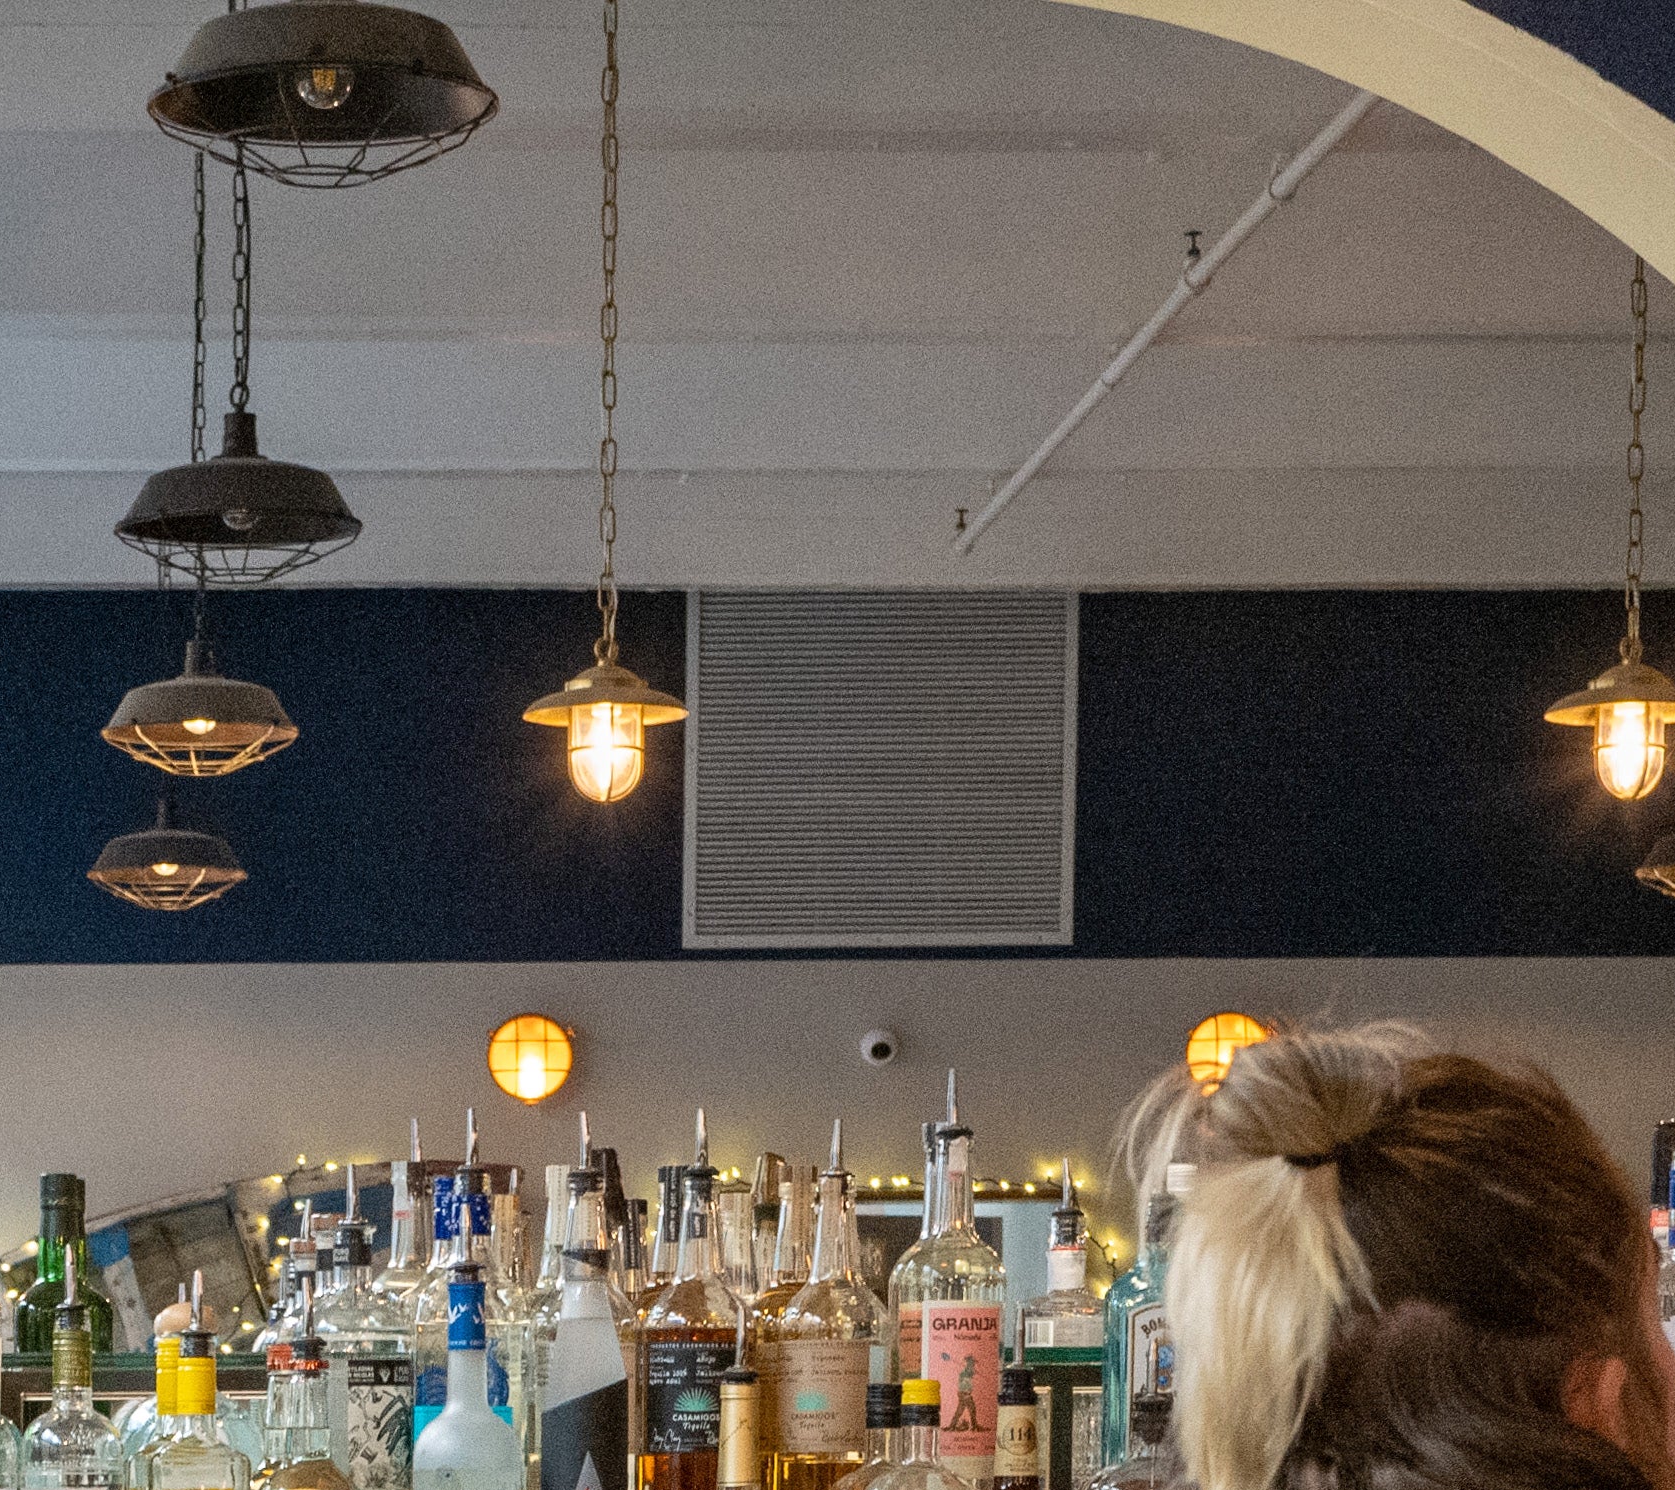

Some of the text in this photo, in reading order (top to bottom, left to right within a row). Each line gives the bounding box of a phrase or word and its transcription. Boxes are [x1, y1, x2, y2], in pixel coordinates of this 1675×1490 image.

[932, 1317, 997, 1331] GRANJA
[1140, 1317, 1167, 1336] BOM
[672, 1413, 720, 1421] CASAMIGOS
[1010, 1427, 1033, 1441] 114
